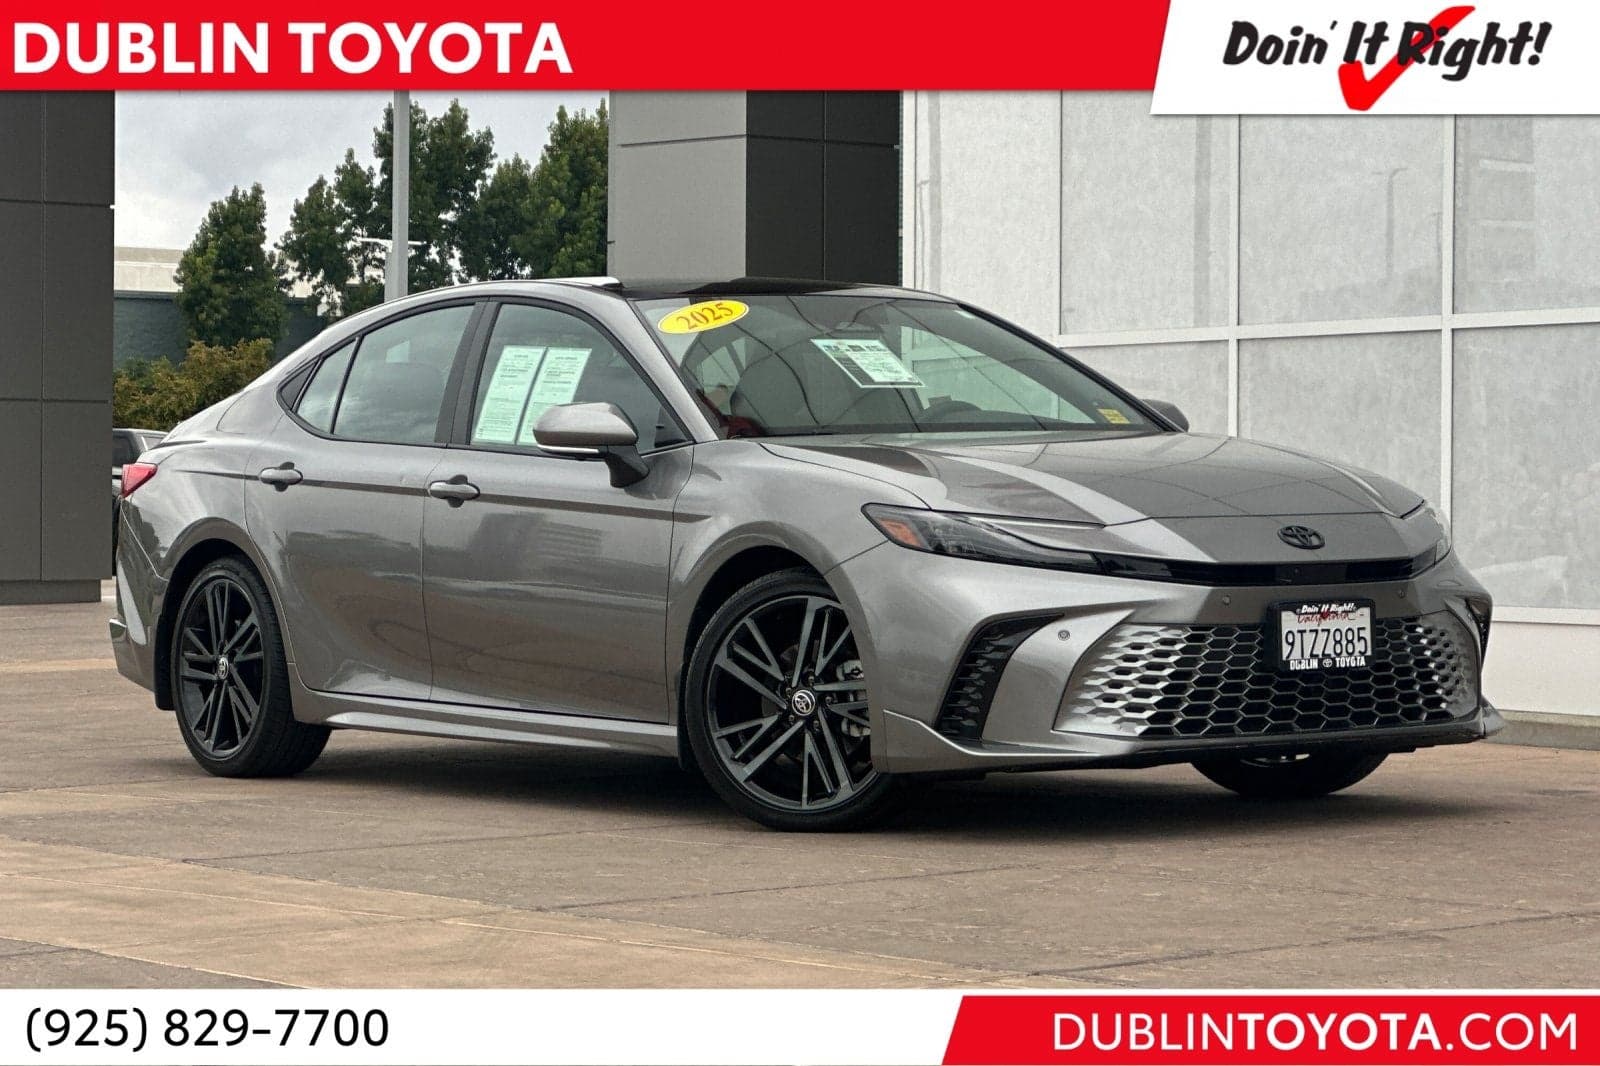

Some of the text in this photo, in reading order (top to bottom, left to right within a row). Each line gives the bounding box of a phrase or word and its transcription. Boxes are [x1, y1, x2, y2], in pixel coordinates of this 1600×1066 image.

[676, 303, 732, 329] 2025
[1285, 628, 1368, 660] 9TZZ885
[1290, 657, 1366, 671] DUBLIN TOYOTA
